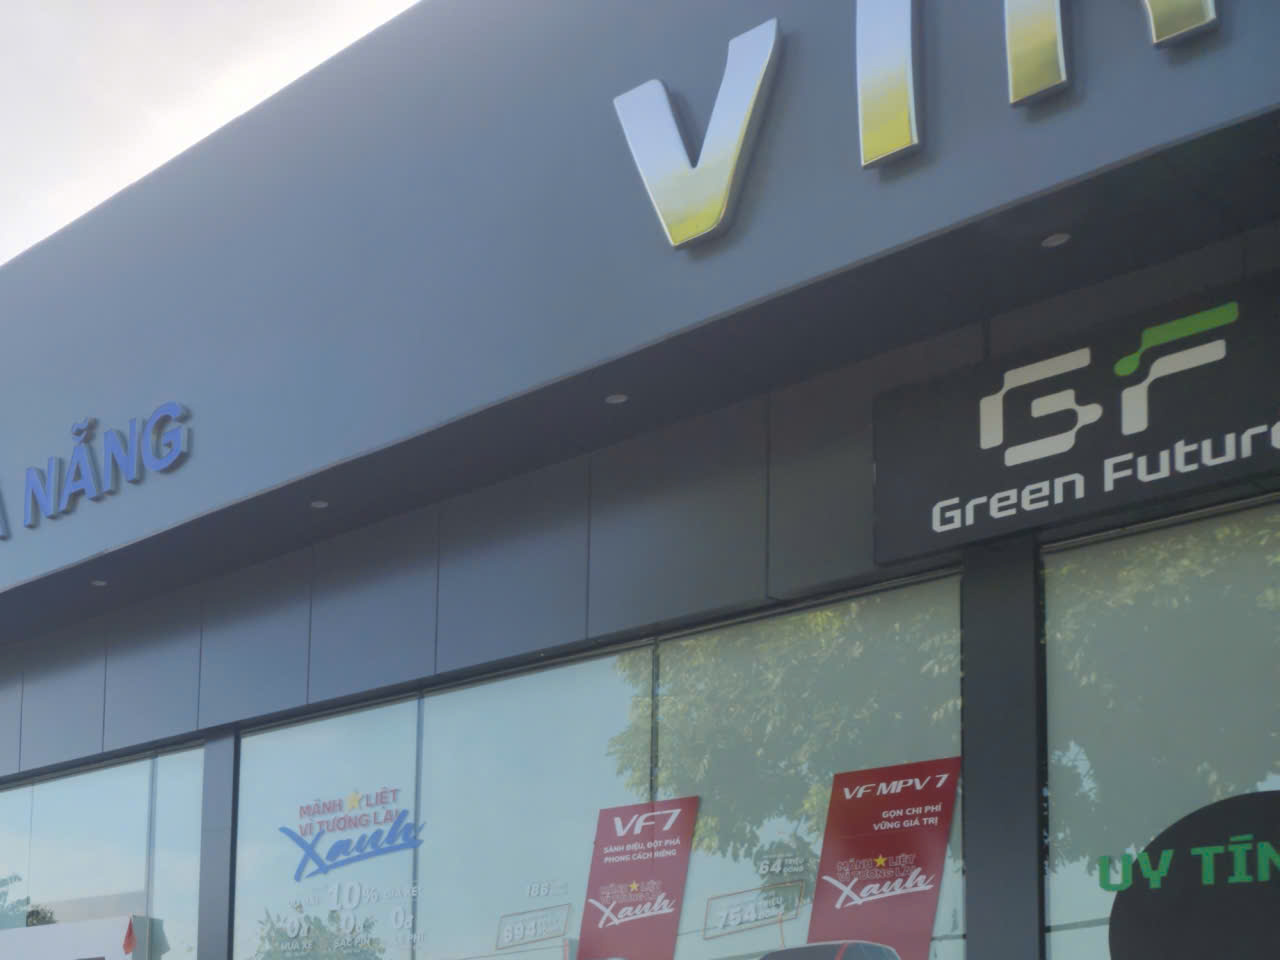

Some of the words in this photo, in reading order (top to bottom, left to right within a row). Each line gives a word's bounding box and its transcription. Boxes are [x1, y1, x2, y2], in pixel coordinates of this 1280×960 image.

[980, 301, 1238, 466] GF
[24, 401, 193, 529] NẴNG
[932, 473, 1084, 533] Green
[843, 784, 876, 800] VF
[876, 776, 931, 796] MPV
[935, 773, 950, 788] 7
[614, 808, 682, 836] VF7
[279, 808, 425, 882] Xanh
[822, 867, 935, 909] Xanh
[1099, 849, 1174, 891] UY
[588, 892, 676, 928] Xanh
